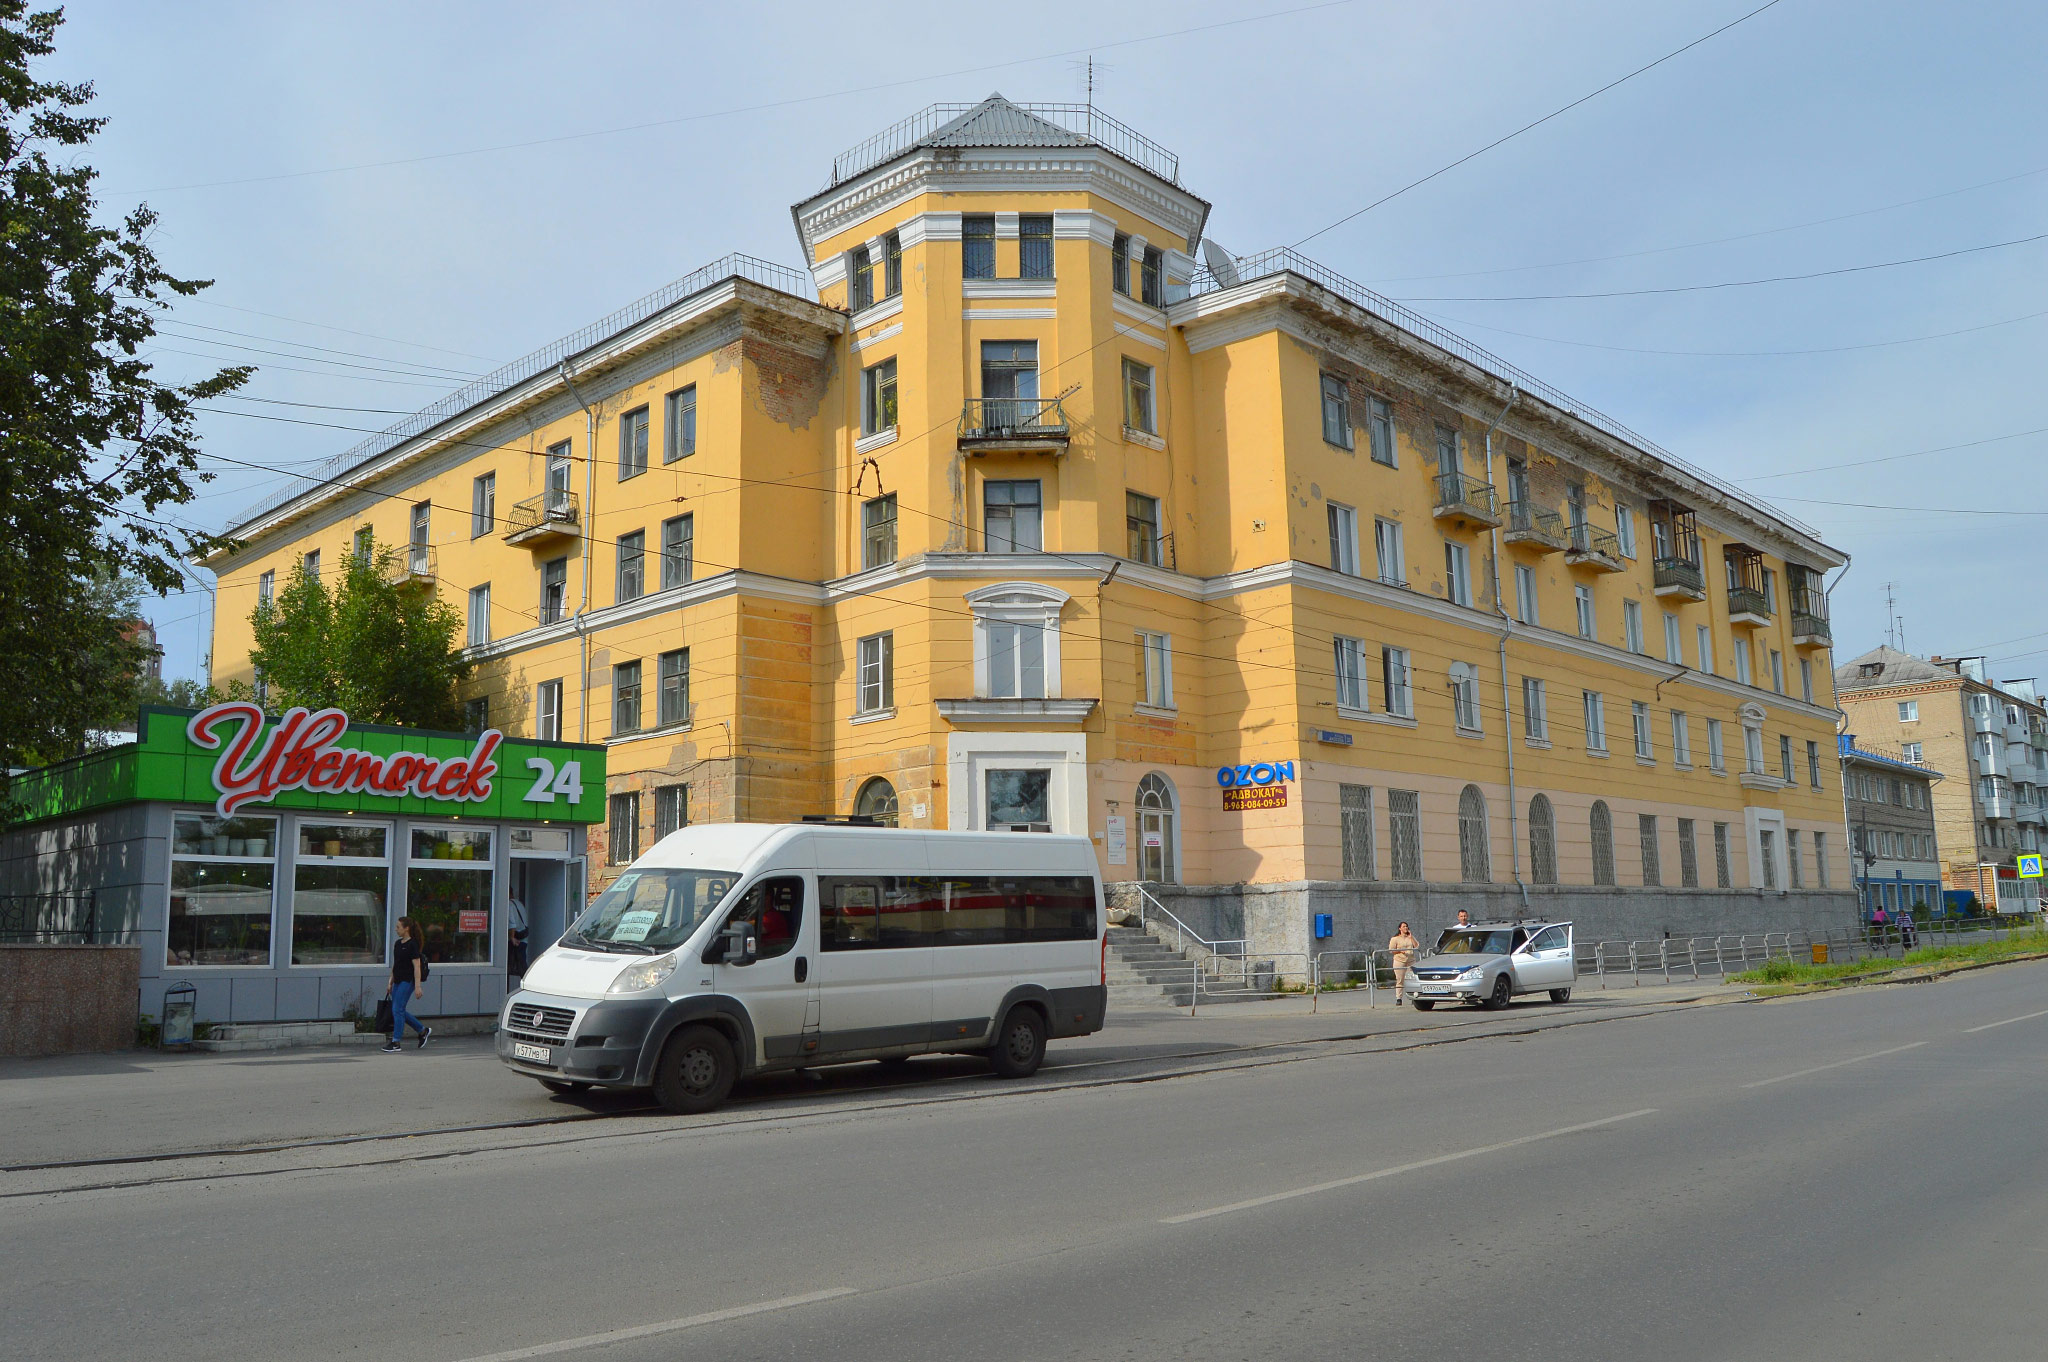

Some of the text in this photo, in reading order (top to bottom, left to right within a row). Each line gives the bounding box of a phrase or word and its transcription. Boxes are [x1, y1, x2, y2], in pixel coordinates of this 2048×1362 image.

[188, 703, 583, 817] Цветочек 24
[1217, 761, 1294, 787] OZON
[1231, 787, 1276, 800] АДВОКАТ
[1224, 798, 1286, 810] 8-963-084-09-59
